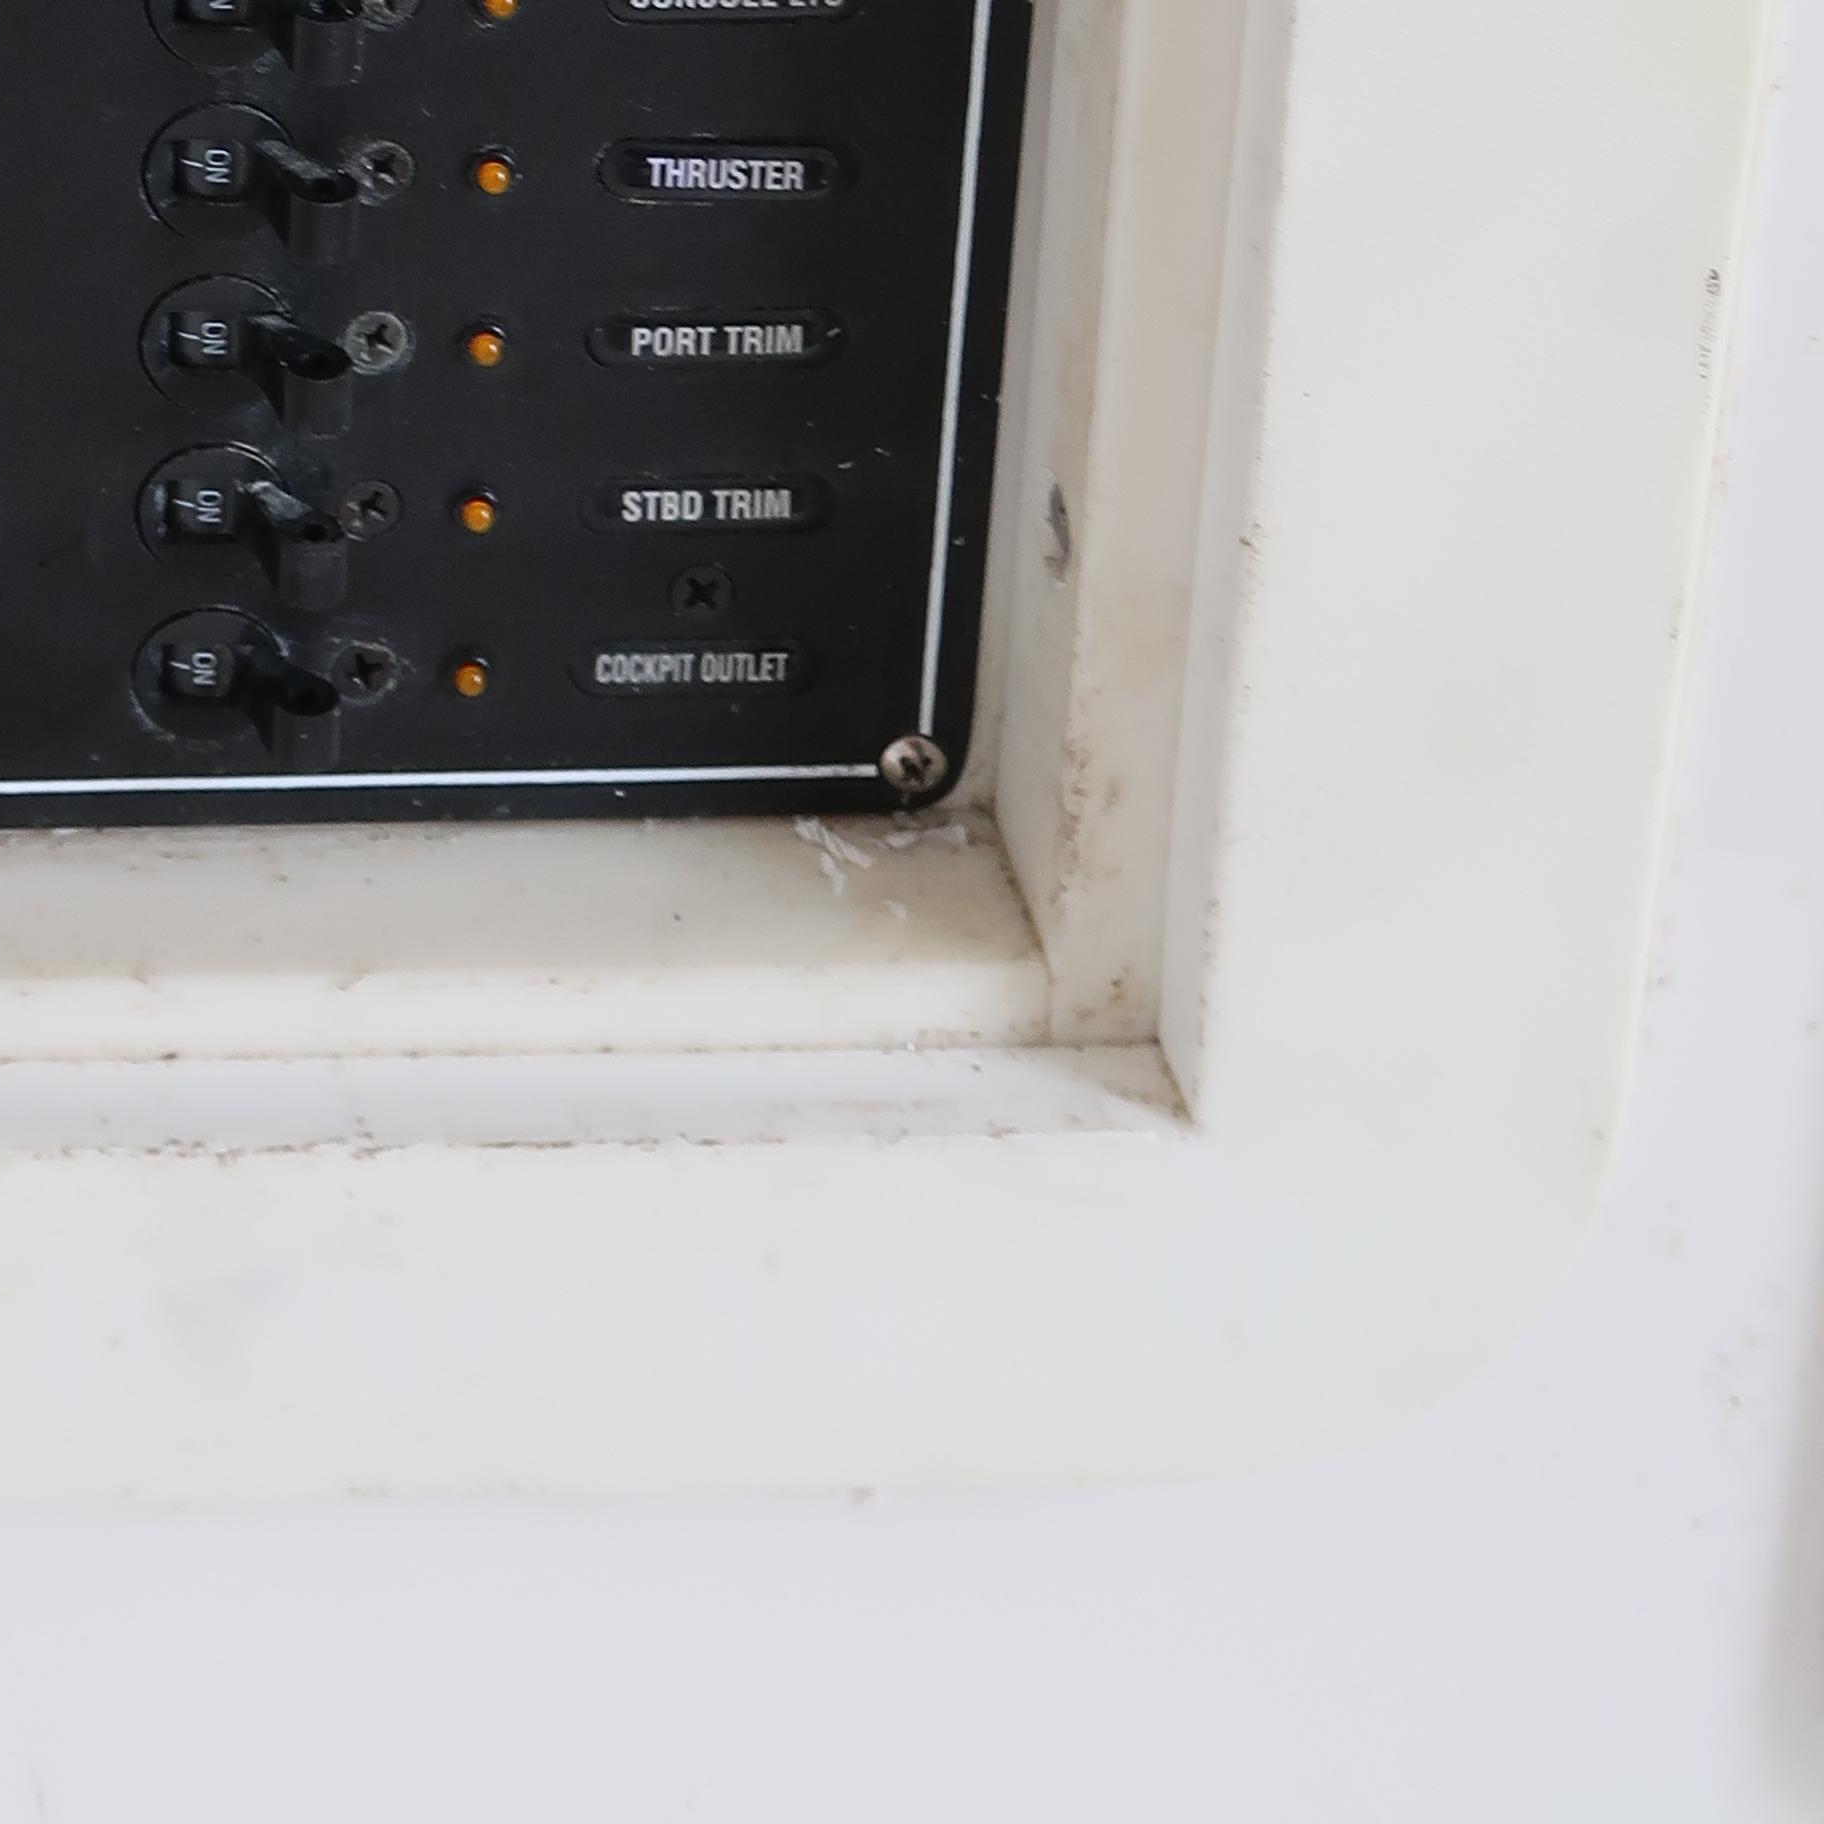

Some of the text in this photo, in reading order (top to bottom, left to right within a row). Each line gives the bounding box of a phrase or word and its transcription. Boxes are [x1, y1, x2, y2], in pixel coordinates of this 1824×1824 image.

[205, 149, 230, 183] ON
[646, 157, 803, 190] THRUSTER
[201, 322, 227, 354] ON
[632, 325, 802, 357] PORT TRIM
[197, 490, 222, 522] ON
[622, 489, 790, 522] STBD TRIM
[192, 652, 216, 685] ON
[596, 652, 788, 683] COCKPIT OUTLET
